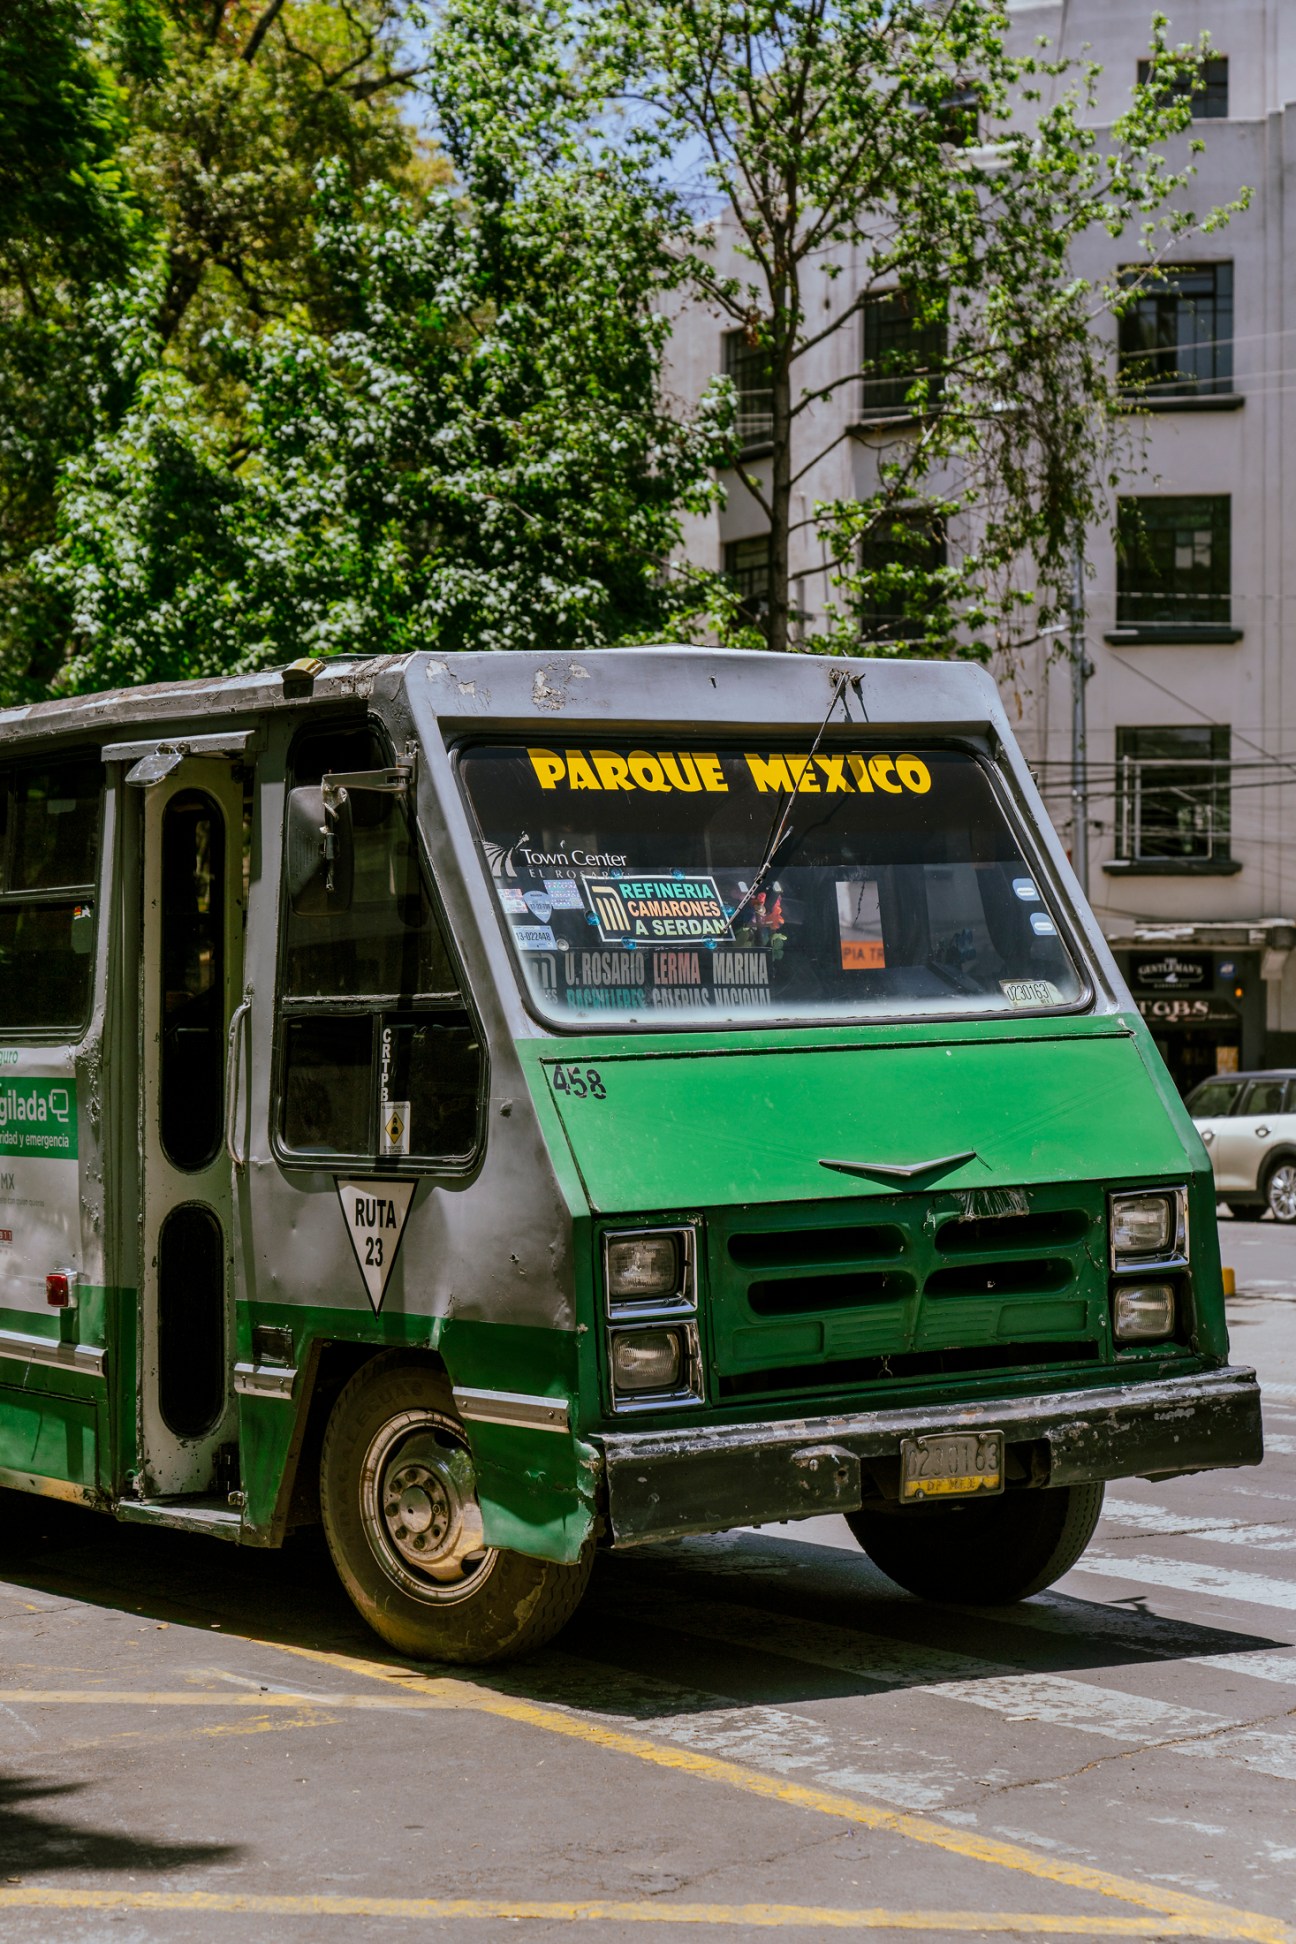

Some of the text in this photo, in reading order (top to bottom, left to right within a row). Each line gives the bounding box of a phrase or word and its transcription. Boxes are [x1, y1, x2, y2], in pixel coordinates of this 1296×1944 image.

[527, 748, 931, 794] PARQUE MEXICO
[520, 849, 627, 867] Town Center
[619, 883, 715, 898] REFINERIA
[627, 901, 721, 917] CAMARONES
[635, 920, 727, 936] A SERDAN
[565, 952, 768, 985] U. ROSARIO LERMA MARINA
[553, 1064, 606, 1099] 458
[19, 1134, 24, 1148] y
[26, 1132, 69, 1149] emergencia
[355, 1198, 397, 1228] RUTA
[365, 1236, 383, 1266] 23
